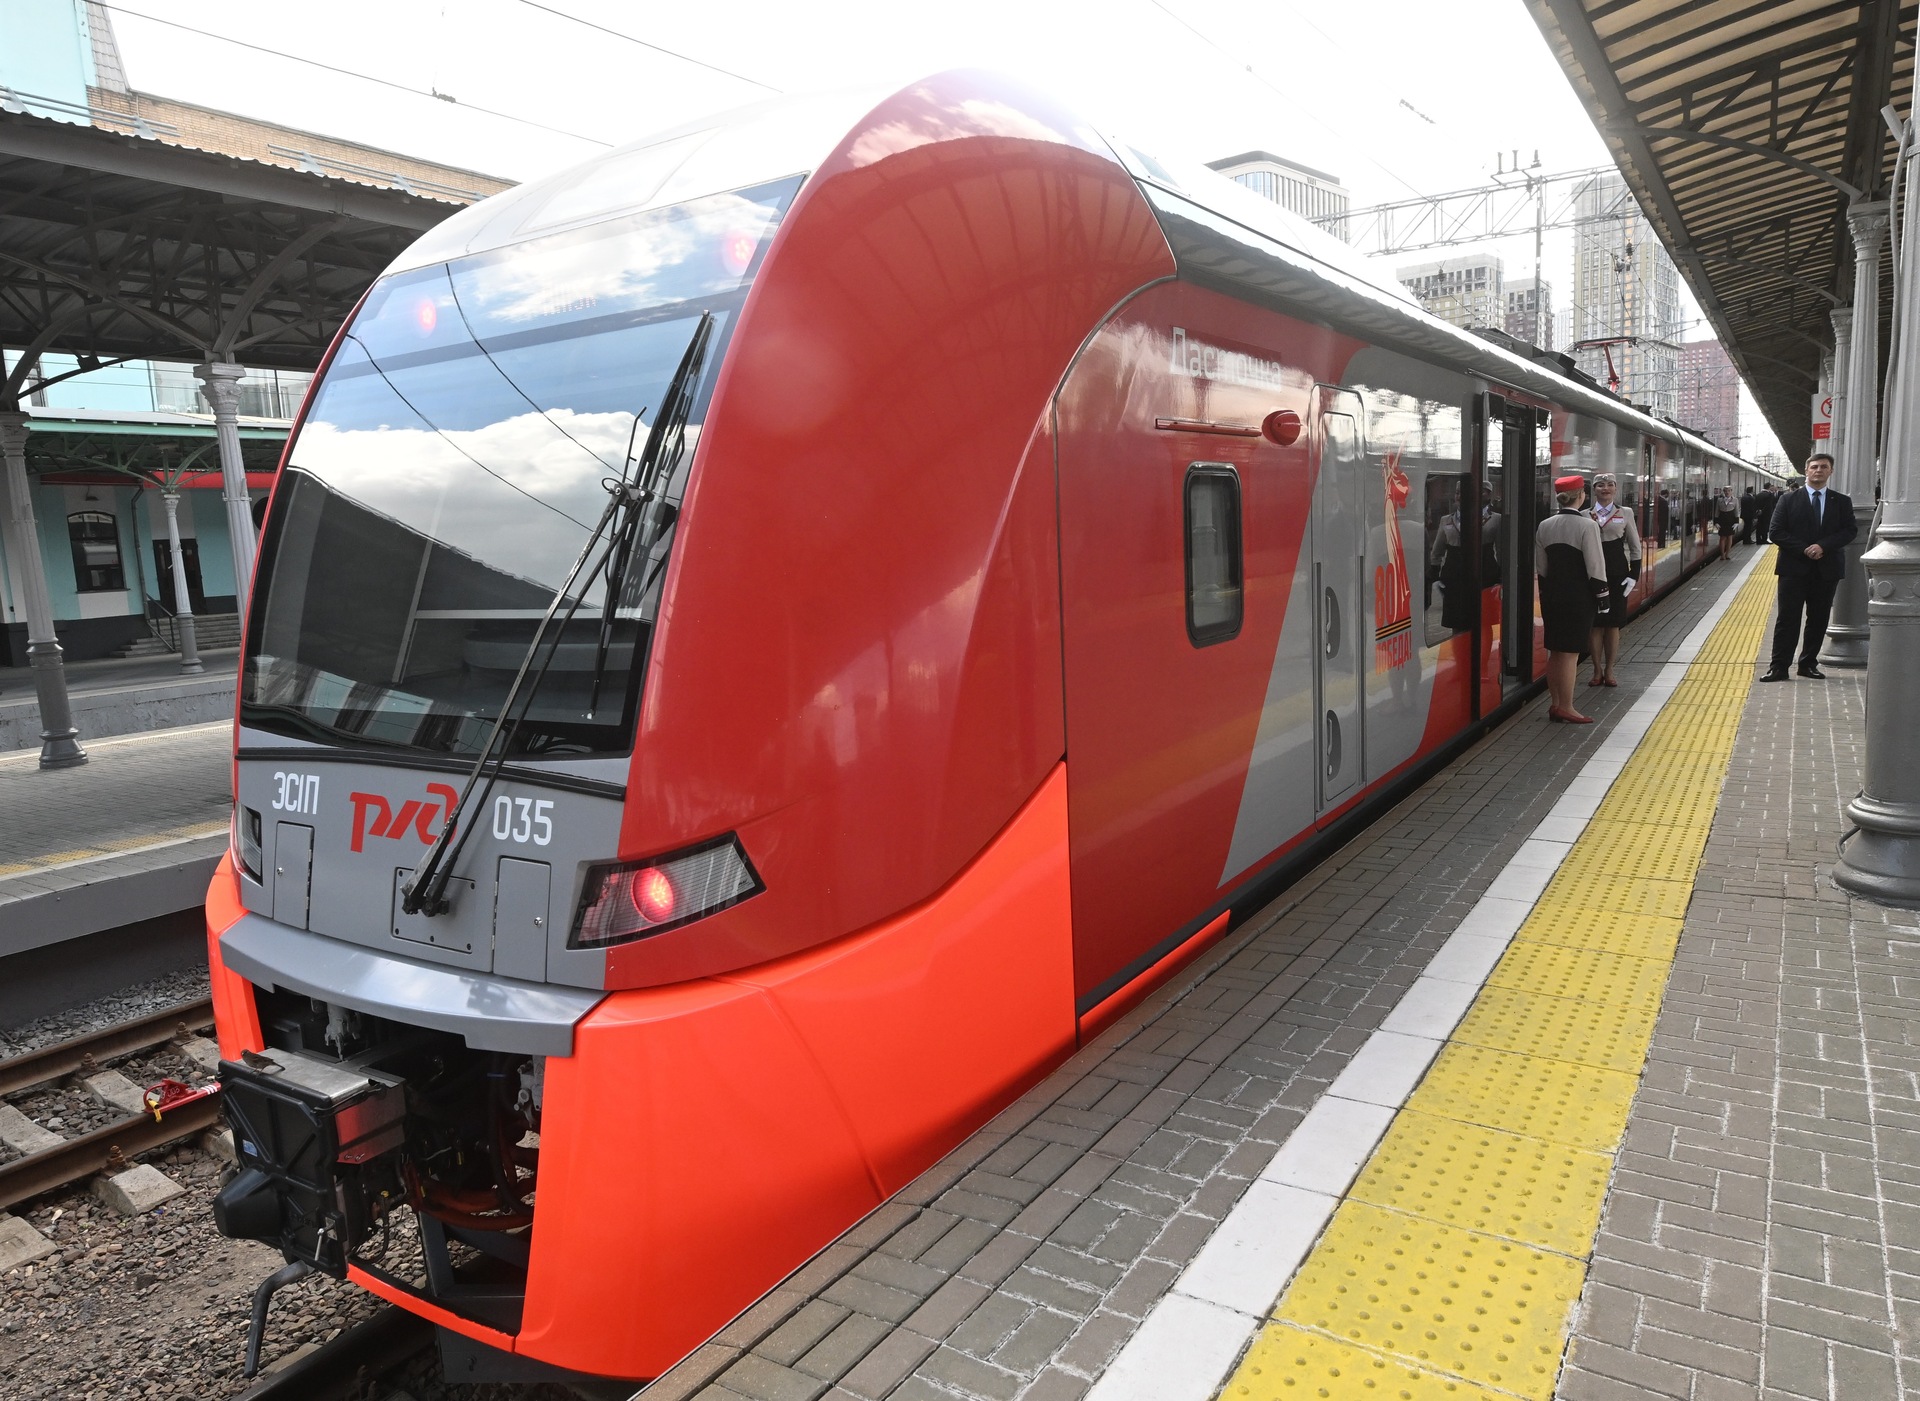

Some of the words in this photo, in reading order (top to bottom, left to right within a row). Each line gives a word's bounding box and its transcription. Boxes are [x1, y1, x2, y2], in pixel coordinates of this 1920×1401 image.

[1374, 562, 1398, 629] 80
[1375, 630, 1412, 675] ПОБЕДА!
[492, 795, 554, 846] 035
